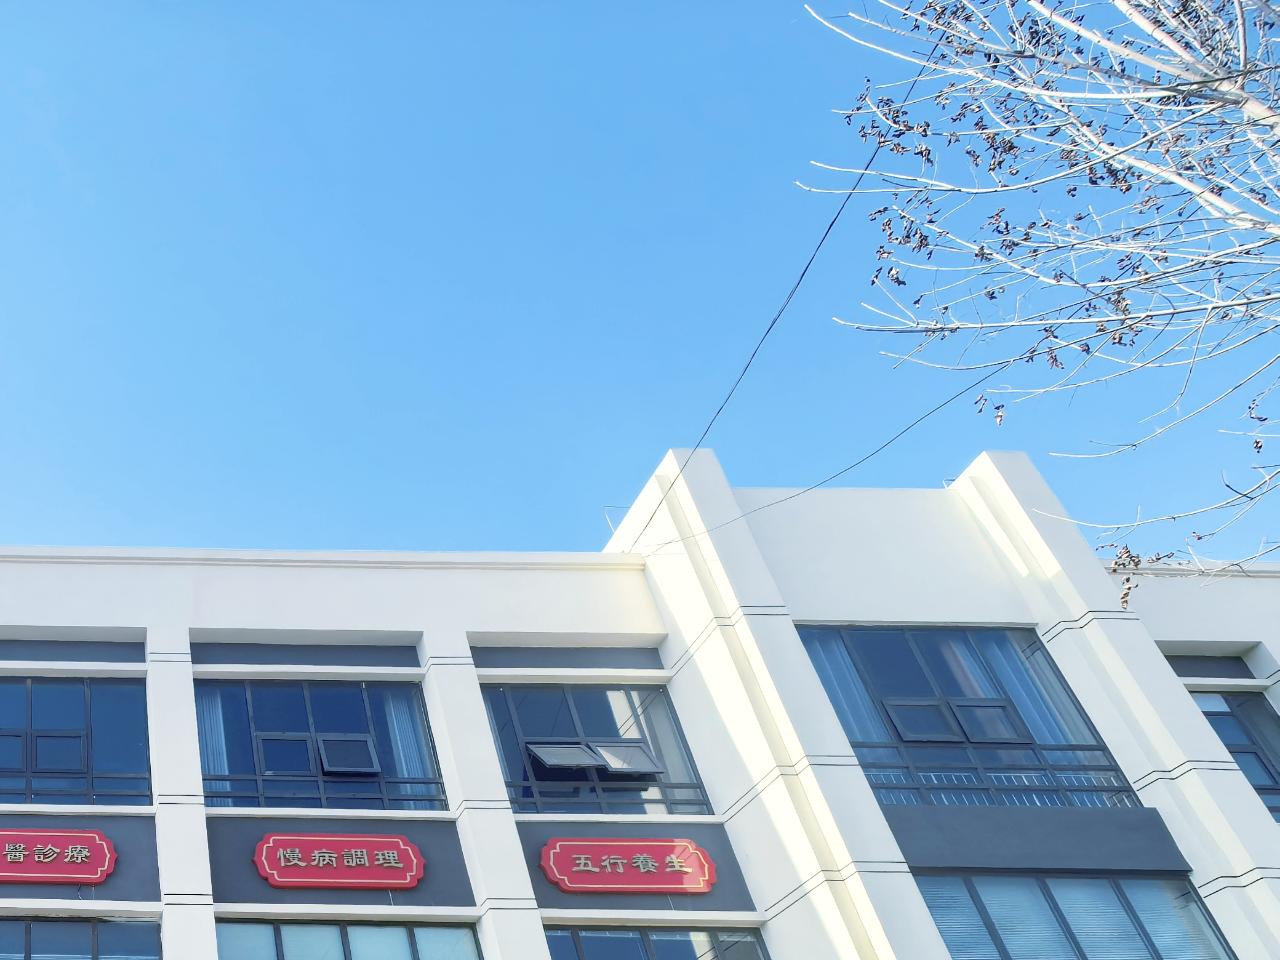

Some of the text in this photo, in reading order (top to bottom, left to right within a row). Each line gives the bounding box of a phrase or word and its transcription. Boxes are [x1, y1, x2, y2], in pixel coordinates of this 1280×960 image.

[276, 847, 405, 868] 慢病調理
[571, 853, 693, 873] 五行養生
